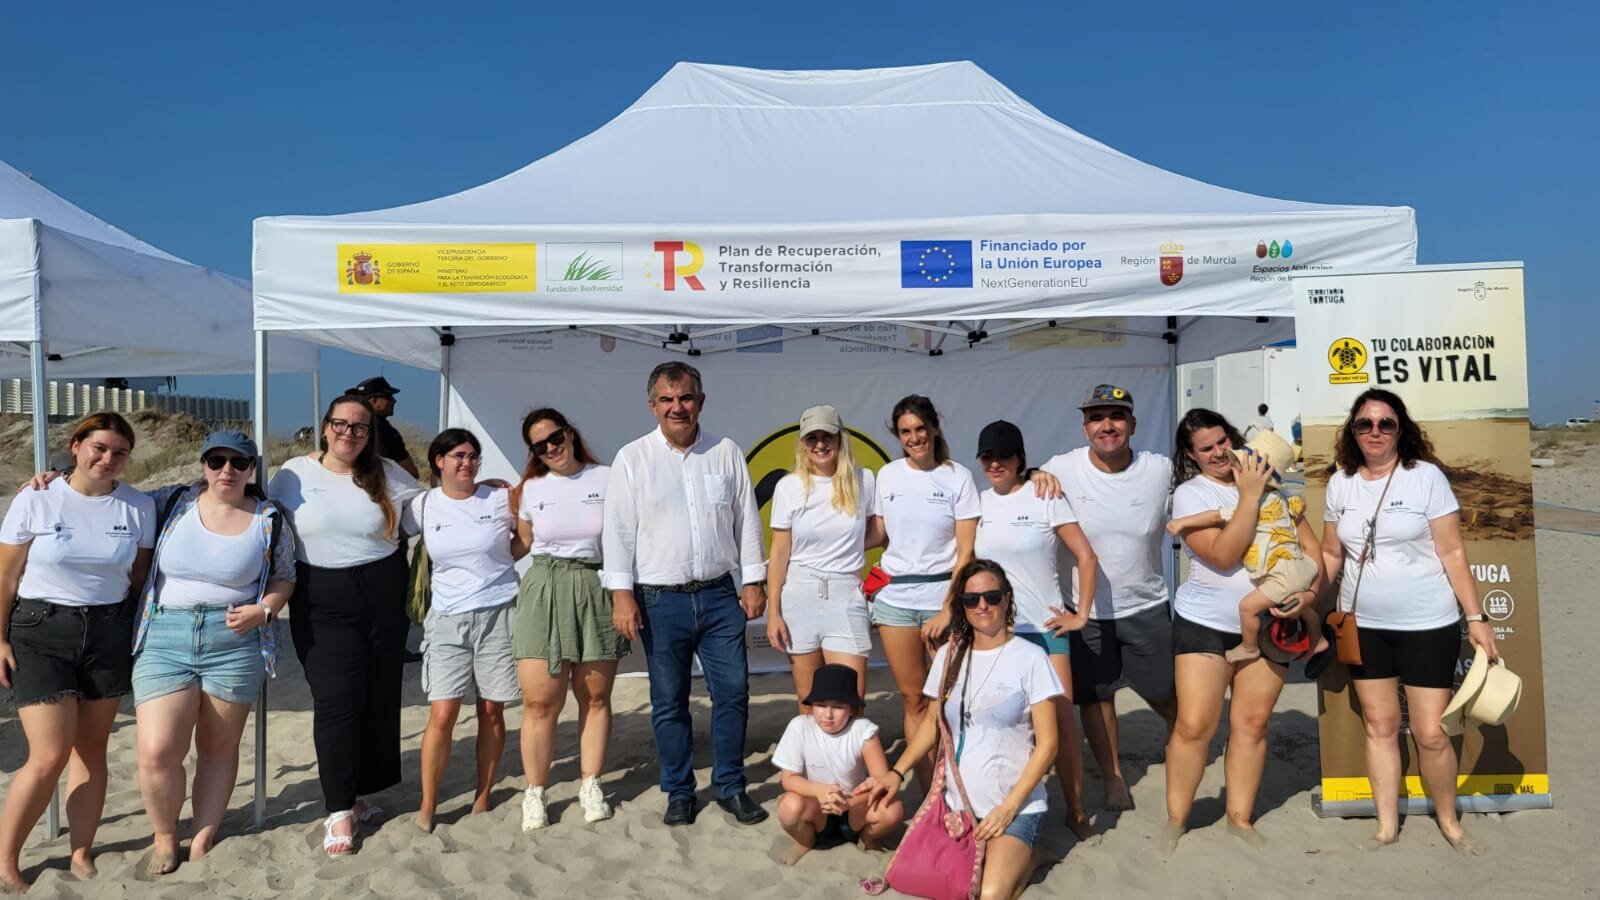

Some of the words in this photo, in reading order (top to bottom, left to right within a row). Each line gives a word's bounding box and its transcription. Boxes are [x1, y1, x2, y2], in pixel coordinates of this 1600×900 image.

[719, 245, 751, 258] Plan
[754, 245, 773, 257] de
[777, 243, 882, 260] Recuperación,
[980, 239, 1059, 252] Financiado
[1062, 241, 1087, 254] por
[718, 260, 834, 273] Transformación
[980, 257, 993, 269] la
[996, 256, 1040, 269] Unión
[1043, 257, 1102, 271] Europea
[1120, 255, 1156, 267] Región
[1186, 255, 1200, 265] de
[1203, 255, 1237, 265] Murcia
[719, 278, 728, 290] y
[732, 276, 811, 289] Resiliencia
[980, 276, 1089, 289] NextGenerationEU
[1308, 295, 1345, 305] TORTUGA
[1371, 338, 1387, 353] TU
[1373, 355, 1410, 385] ES
[1418, 353, 1497, 383] VITAL
[1489, 597, 1508, 607] 112
